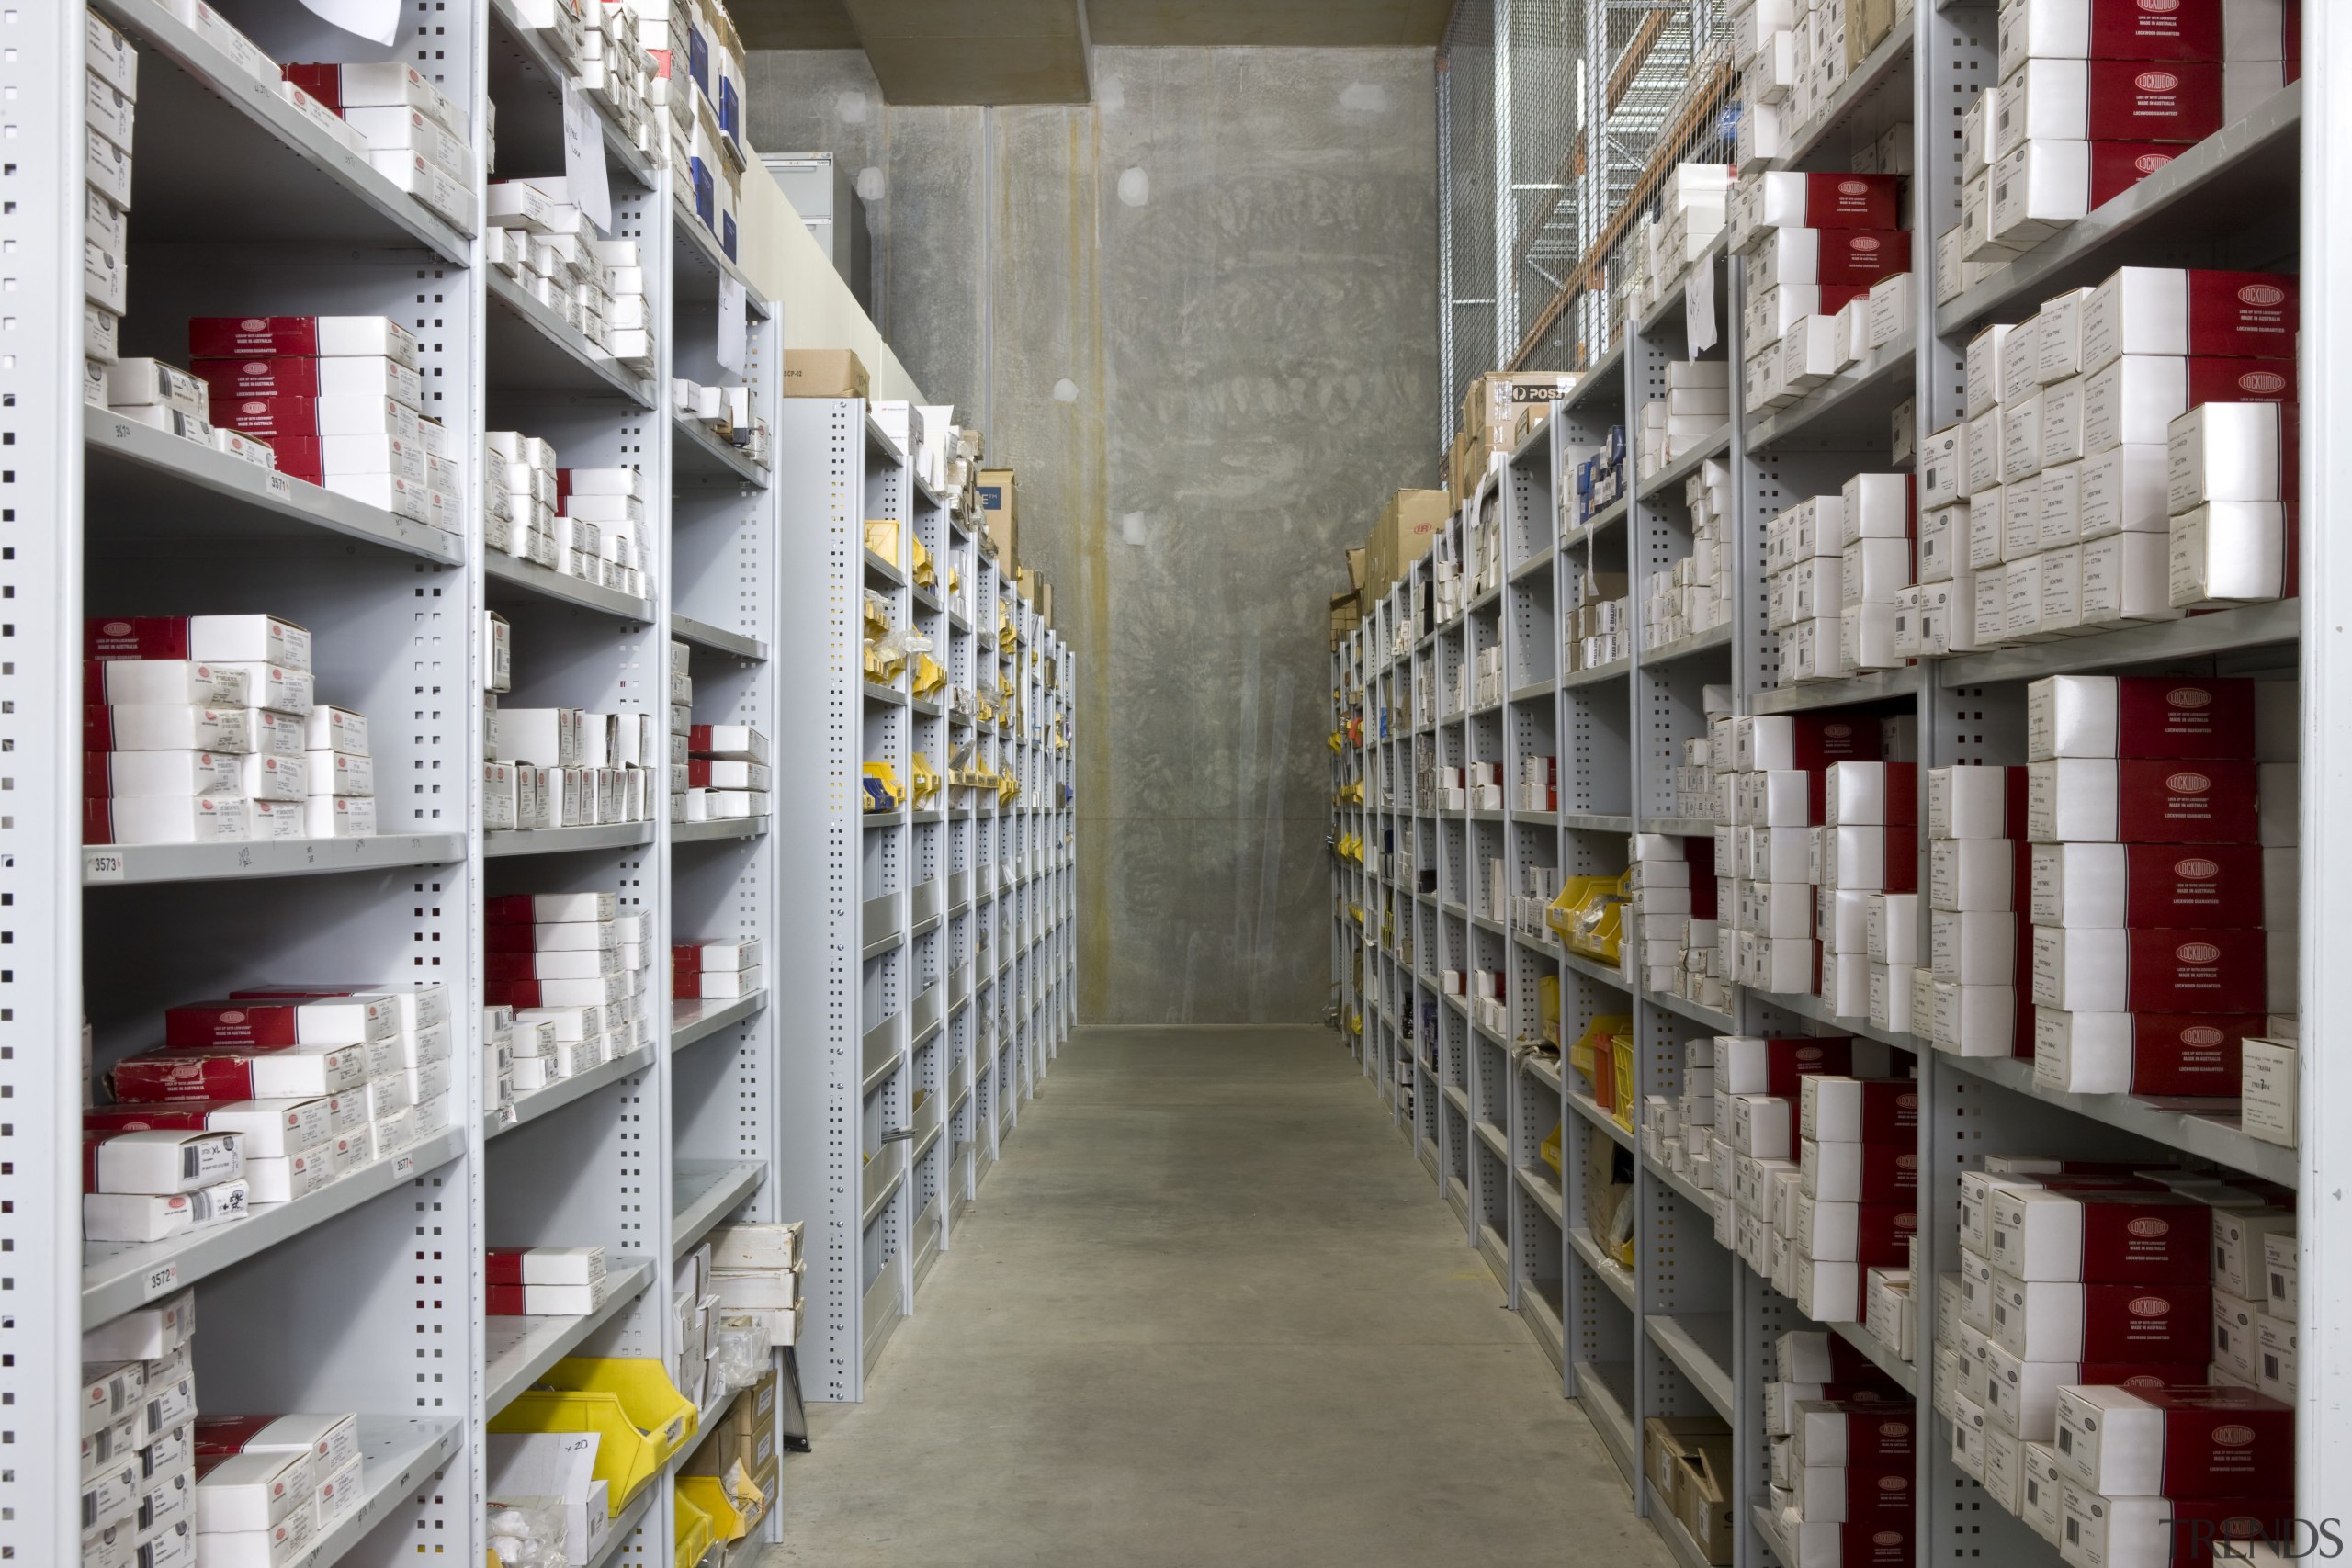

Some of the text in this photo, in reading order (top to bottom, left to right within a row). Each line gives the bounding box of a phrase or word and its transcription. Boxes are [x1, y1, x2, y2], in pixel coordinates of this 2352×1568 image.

[2139, 74, 2175, 89] LOCKWOOD
[2241, 287, 2282, 304] LOCKWOOD
[2242, 374, 2282, 391] LOCKWOOD
[271, 476, 285, 491] 3571
[2170, 690, 2209, 705] LOCKWOOD
[2170, 775, 2208, 791] LOCKWOOD
[95, 858, 115, 871] 3573
[2178, 861, 2215, 877] LOCKWOOD
[2179, 946, 2217, 961] LOCKWOOD
[2183, 1029, 2221, 1044] LOCKWOOD
[212, 1145, 221, 1155] XL
[2131, 1219, 2165, 1235] LOCKWOOD
[151, 1269, 171, 1289] 3572
[2132, 1300, 2167, 1314] LOCKWOOD
[2214, 1427, 2252, 1443] LOCKWOOD
[574, 1440, 588, 1451] 20
